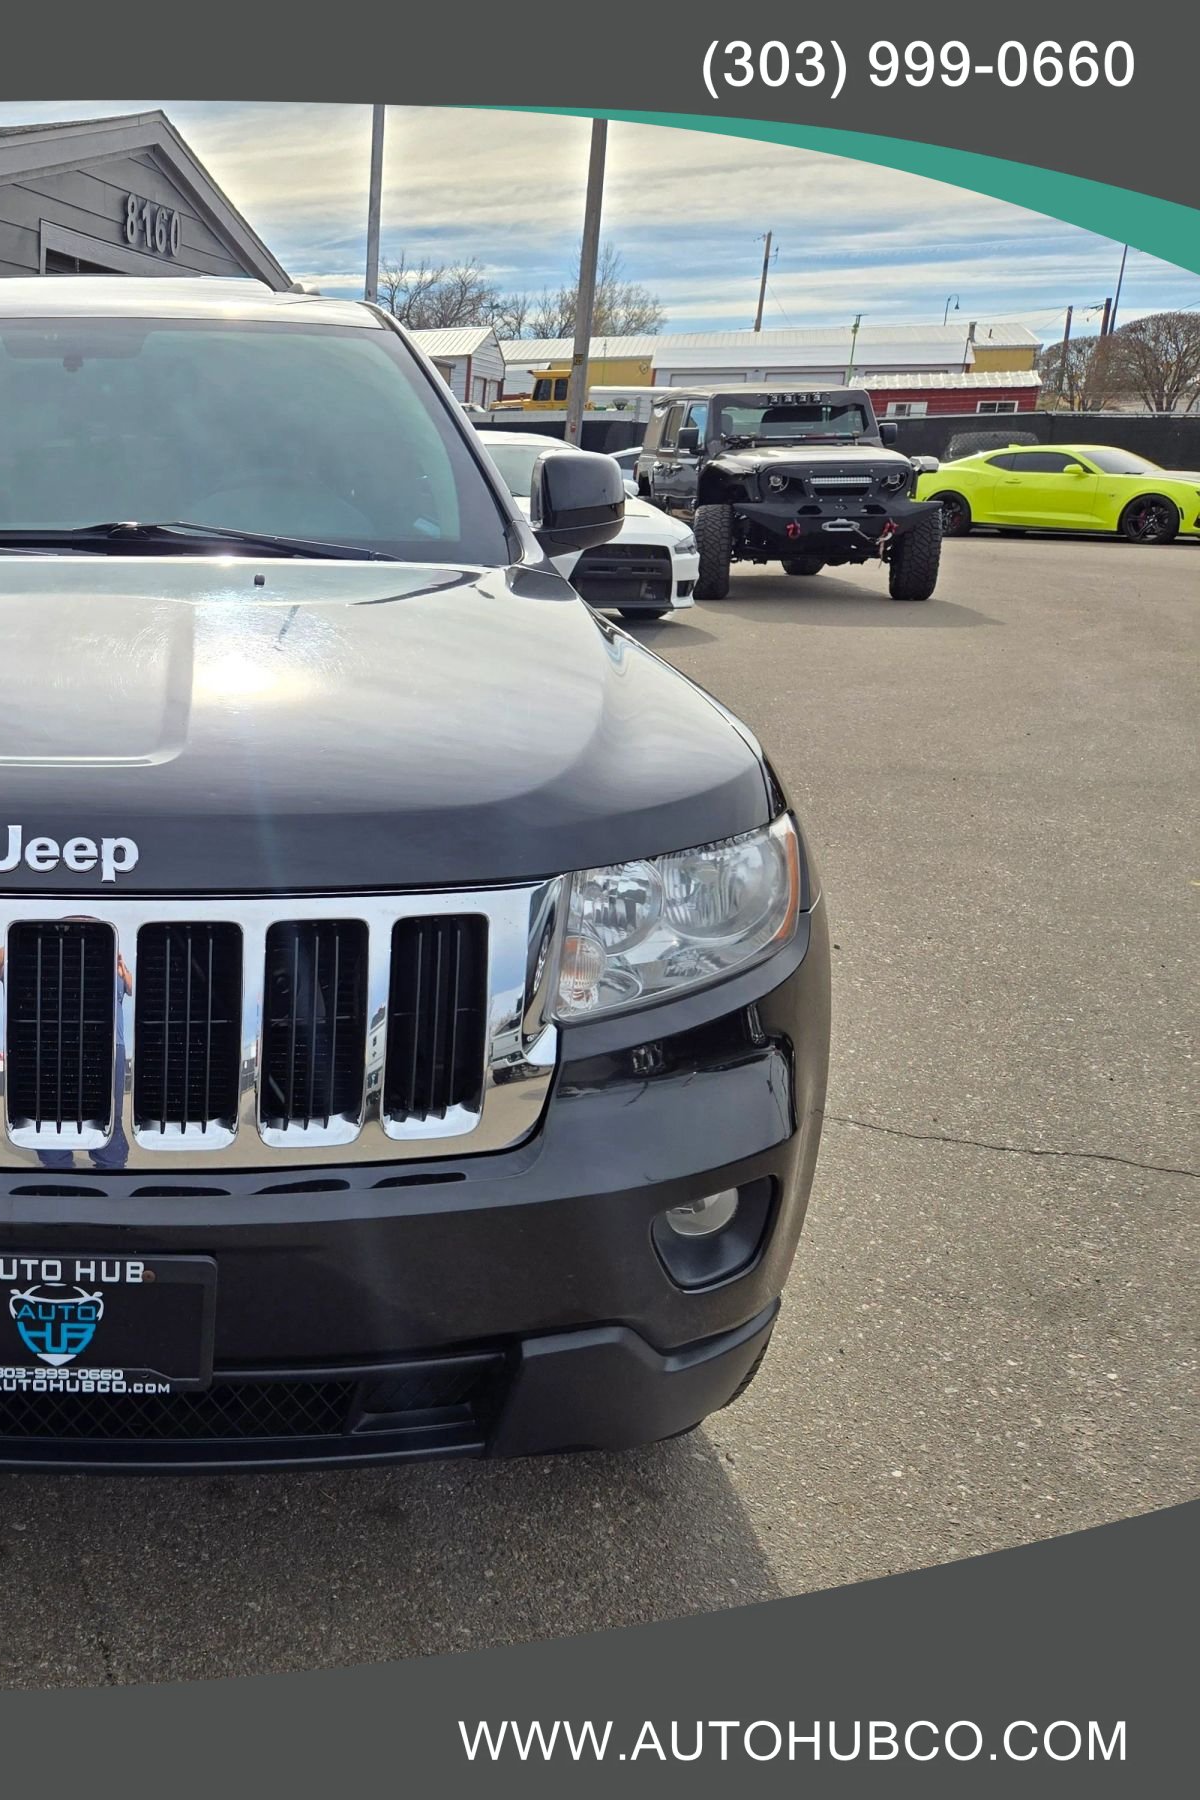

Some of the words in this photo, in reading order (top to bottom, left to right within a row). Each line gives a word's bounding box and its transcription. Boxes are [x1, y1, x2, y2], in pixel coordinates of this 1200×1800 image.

[126, 194, 182, 258] 8160
[75, 1261, 145, 1283] HUB
[16, 1303, 97, 1321] AUTO
[16, 1322, 97, 1354] HUB
